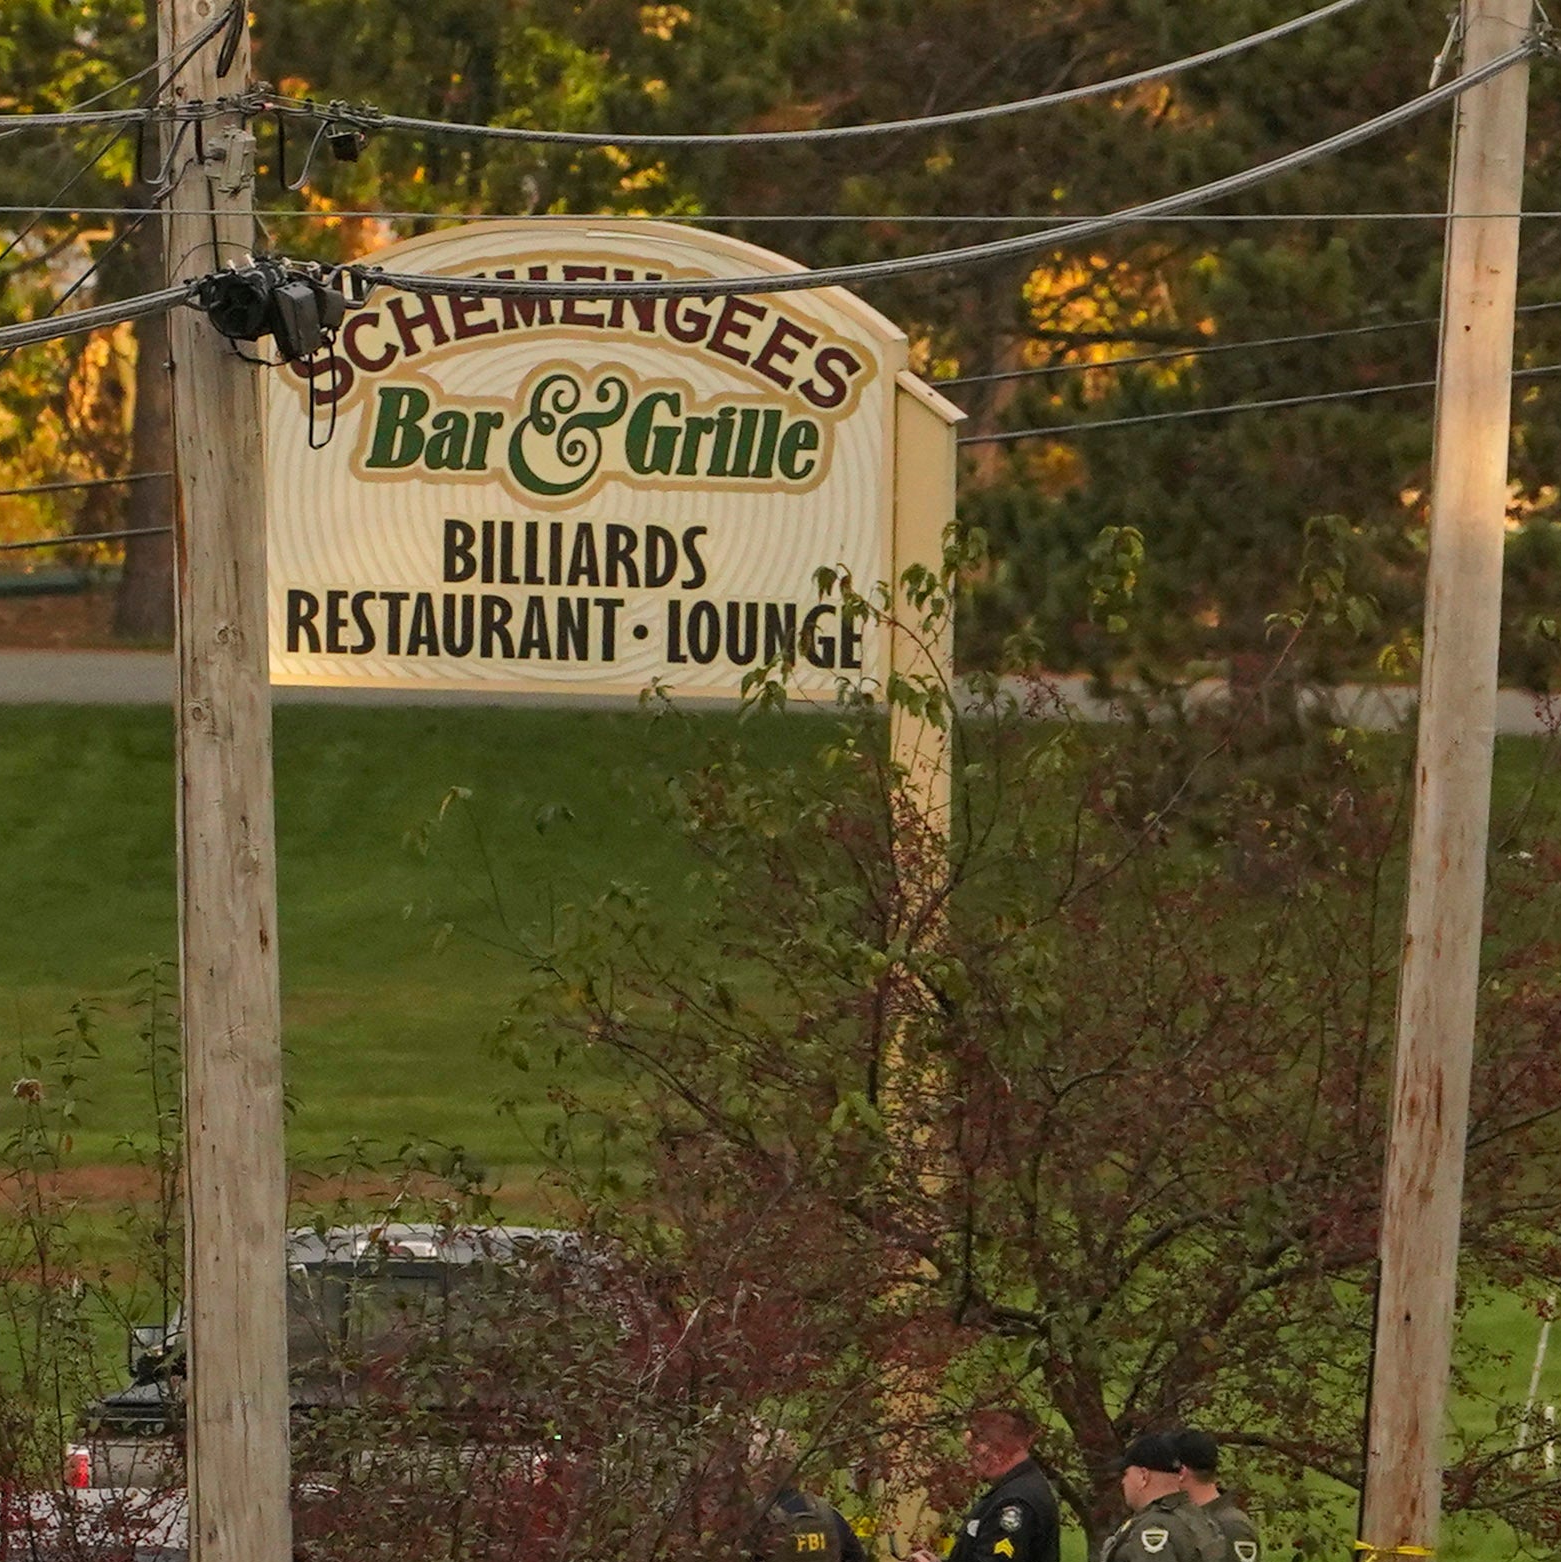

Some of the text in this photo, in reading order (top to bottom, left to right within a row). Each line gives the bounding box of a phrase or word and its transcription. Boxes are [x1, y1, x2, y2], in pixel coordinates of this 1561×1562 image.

[290, 265, 861, 408] SCHEMENGEES
[366, 374, 820, 496] Bar & Grille
[444, 519, 709, 589] BILLIARDS
[287, 590, 625, 662] RESTAURANT
[667, 600, 863, 669] LOUNGE
[795, 1533, 825, 1551] FBI
